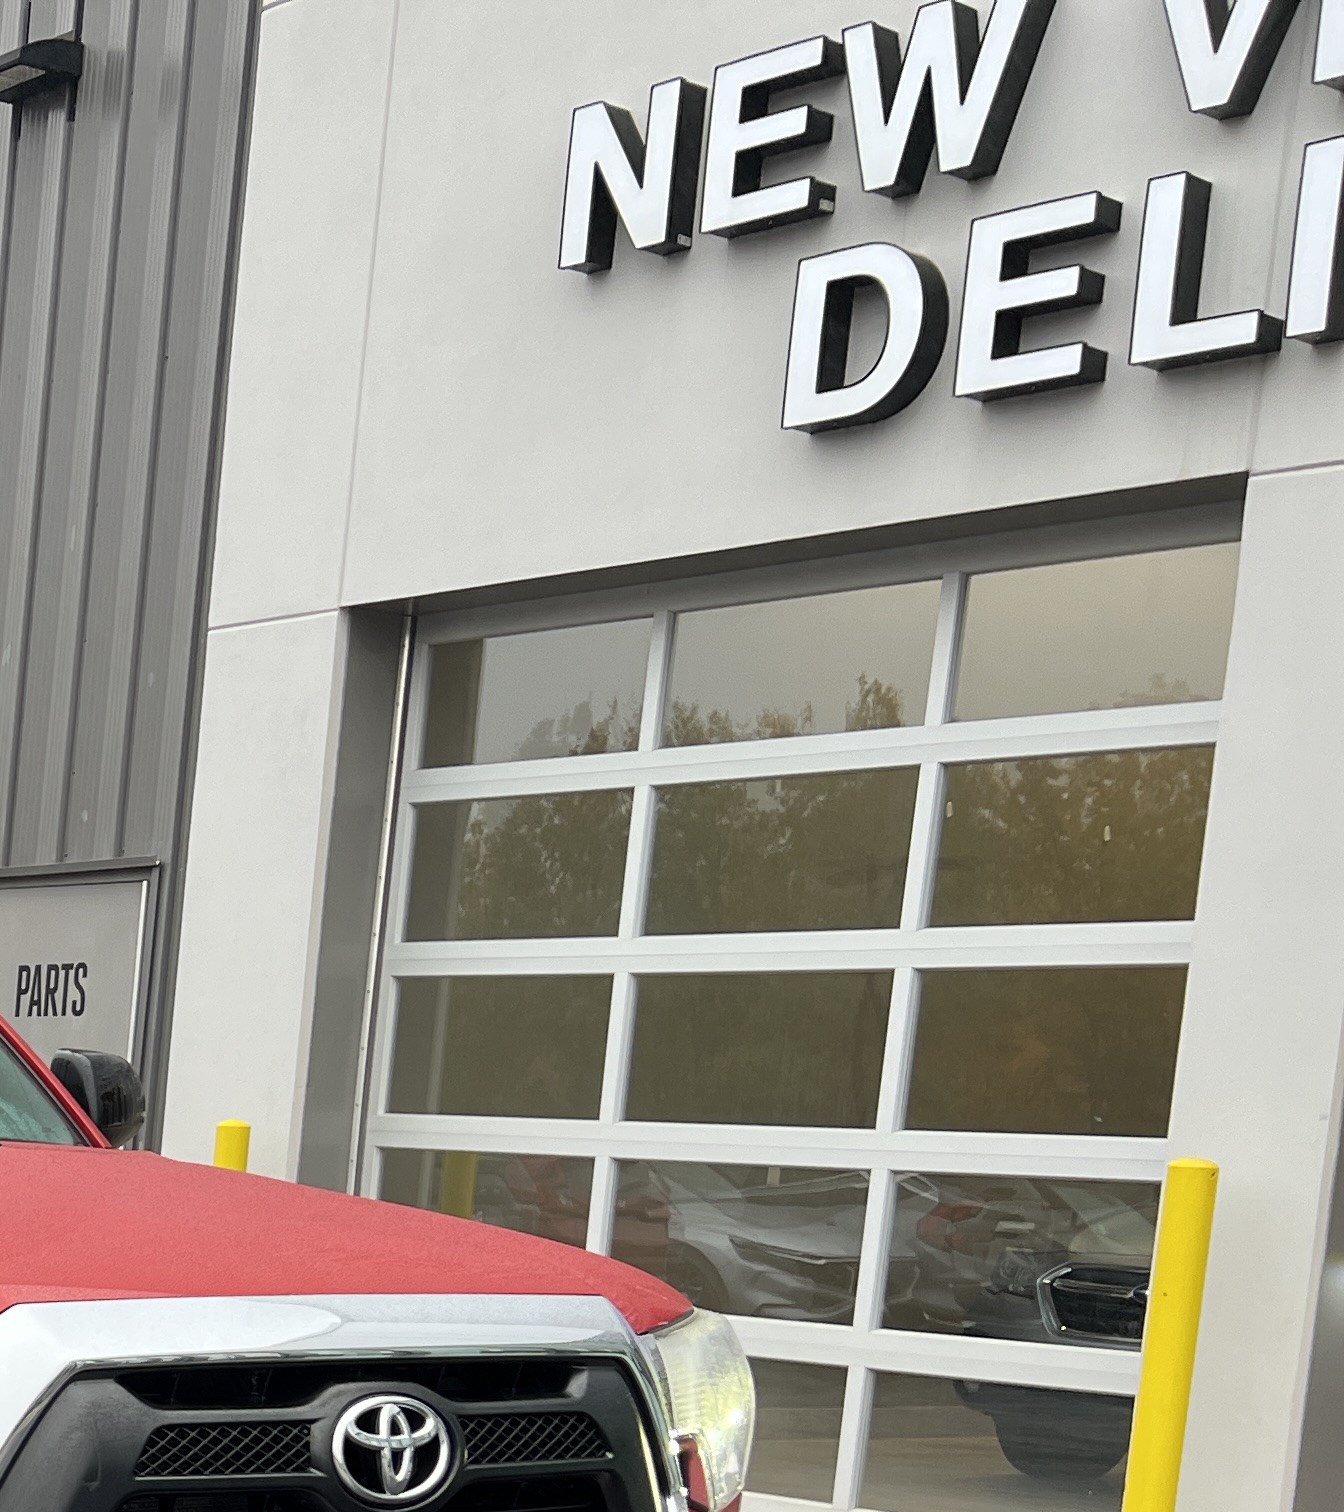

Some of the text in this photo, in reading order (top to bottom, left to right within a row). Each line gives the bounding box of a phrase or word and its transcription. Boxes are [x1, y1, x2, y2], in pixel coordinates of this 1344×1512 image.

[558, 0, 1057, 273] NEW
[780, 135, 1344, 435] DELI
[14, 962, 88, 1018] PARTS
